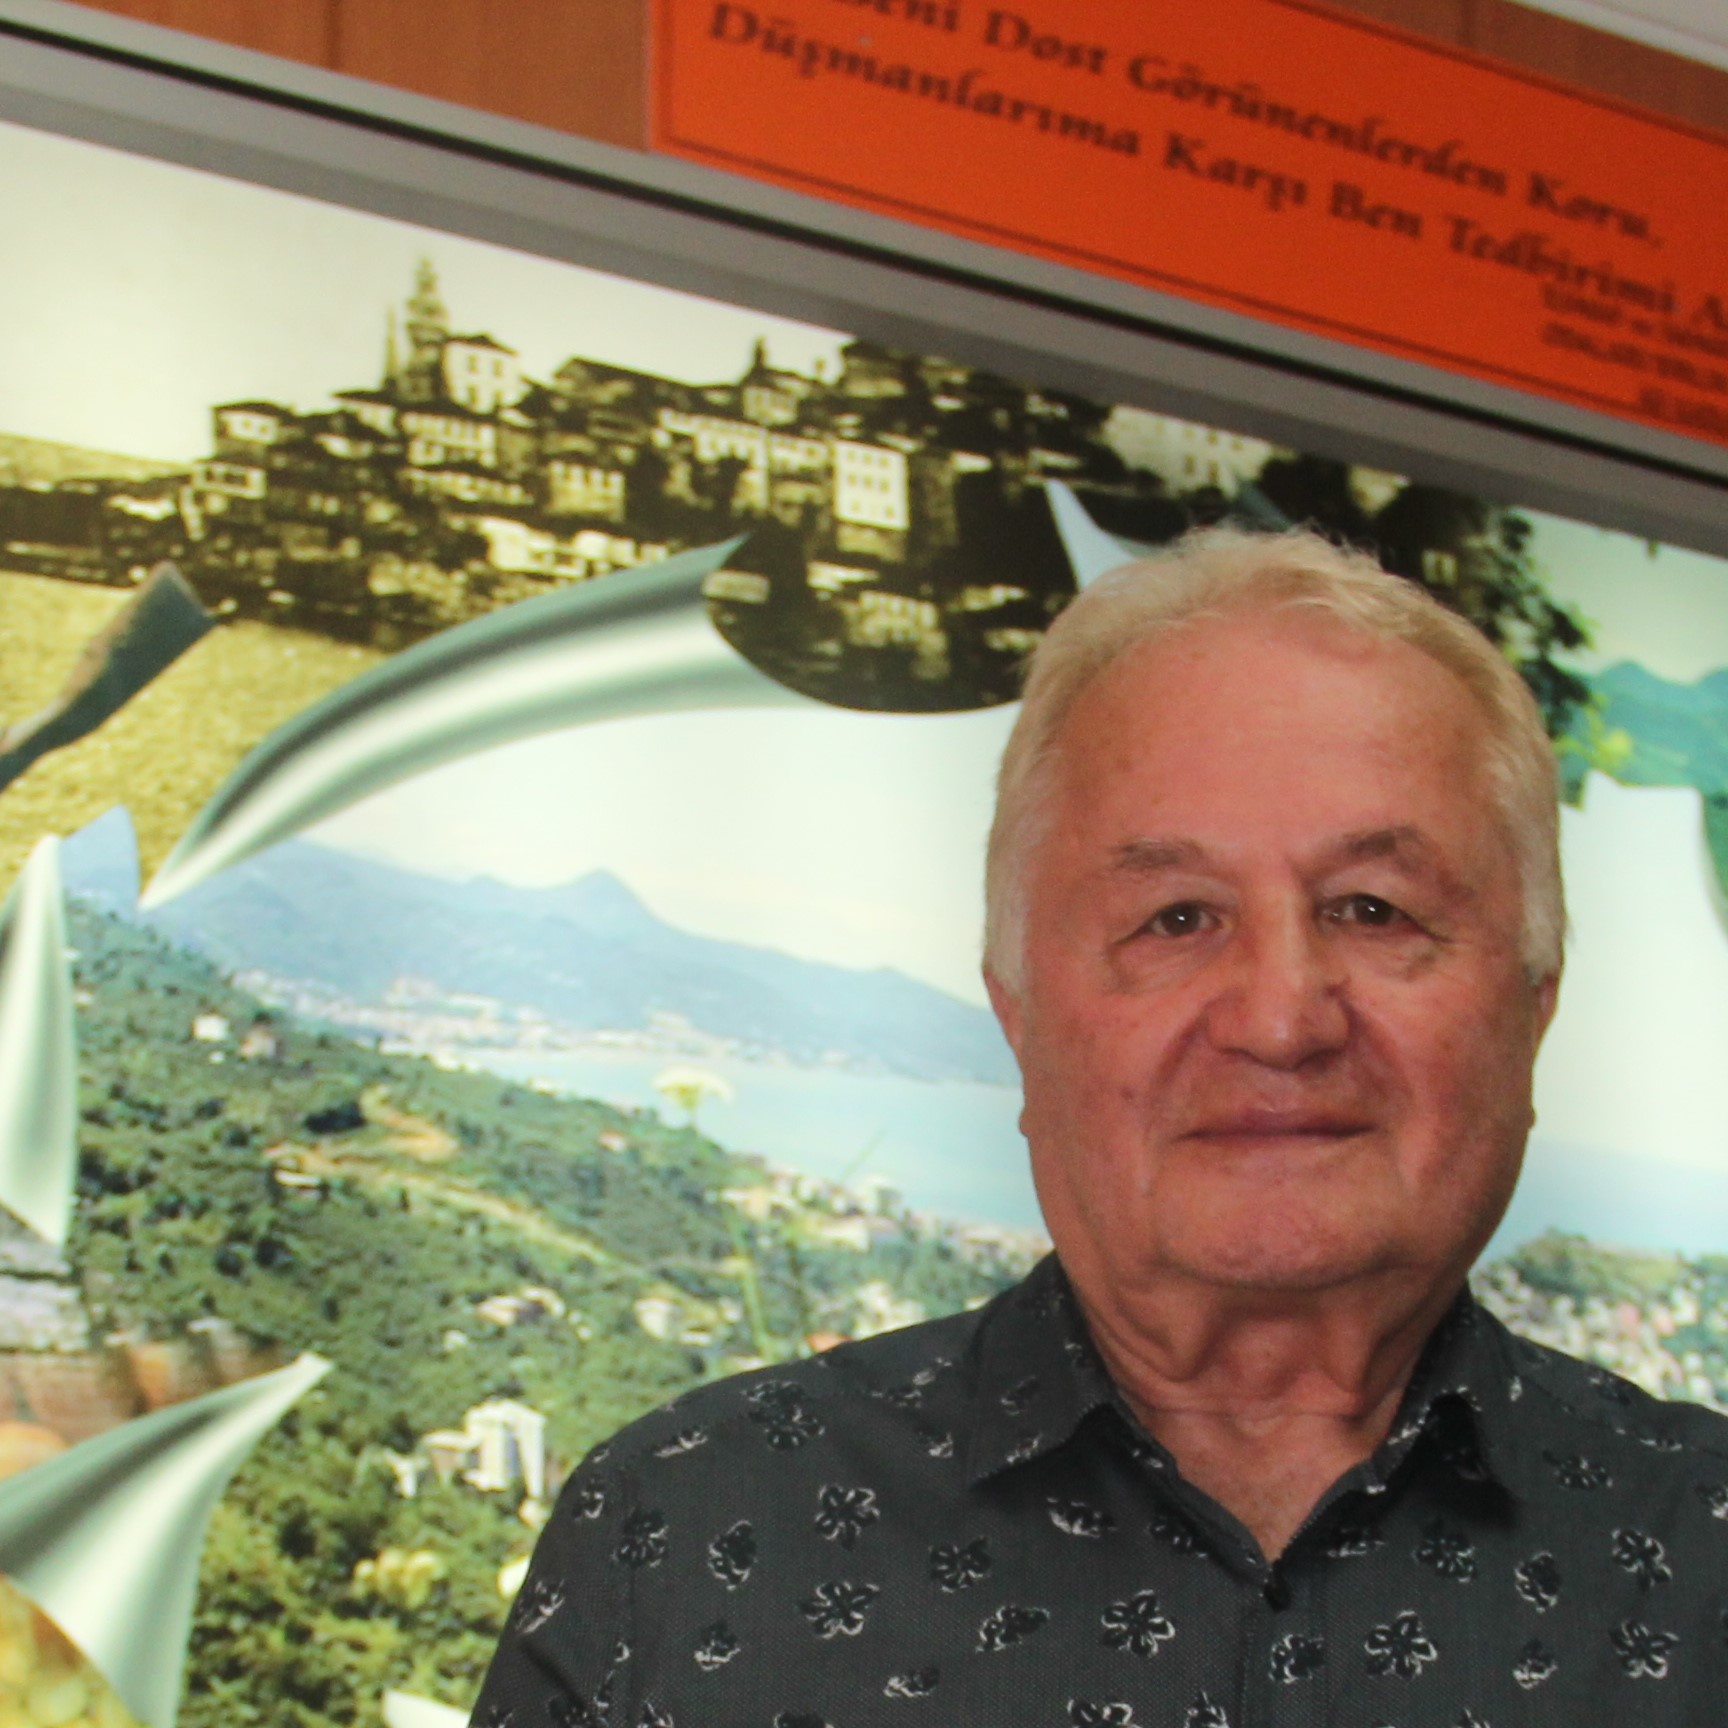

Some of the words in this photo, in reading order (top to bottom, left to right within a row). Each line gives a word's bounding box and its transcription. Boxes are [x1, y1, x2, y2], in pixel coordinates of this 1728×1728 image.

[982, 9, 1108, 76] Dost
[708, 2, 1141, 157] Düşmanlarıma
[1162, 130, 1308, 212] Karşı
[1327, 181, 1424, 239] Ben
